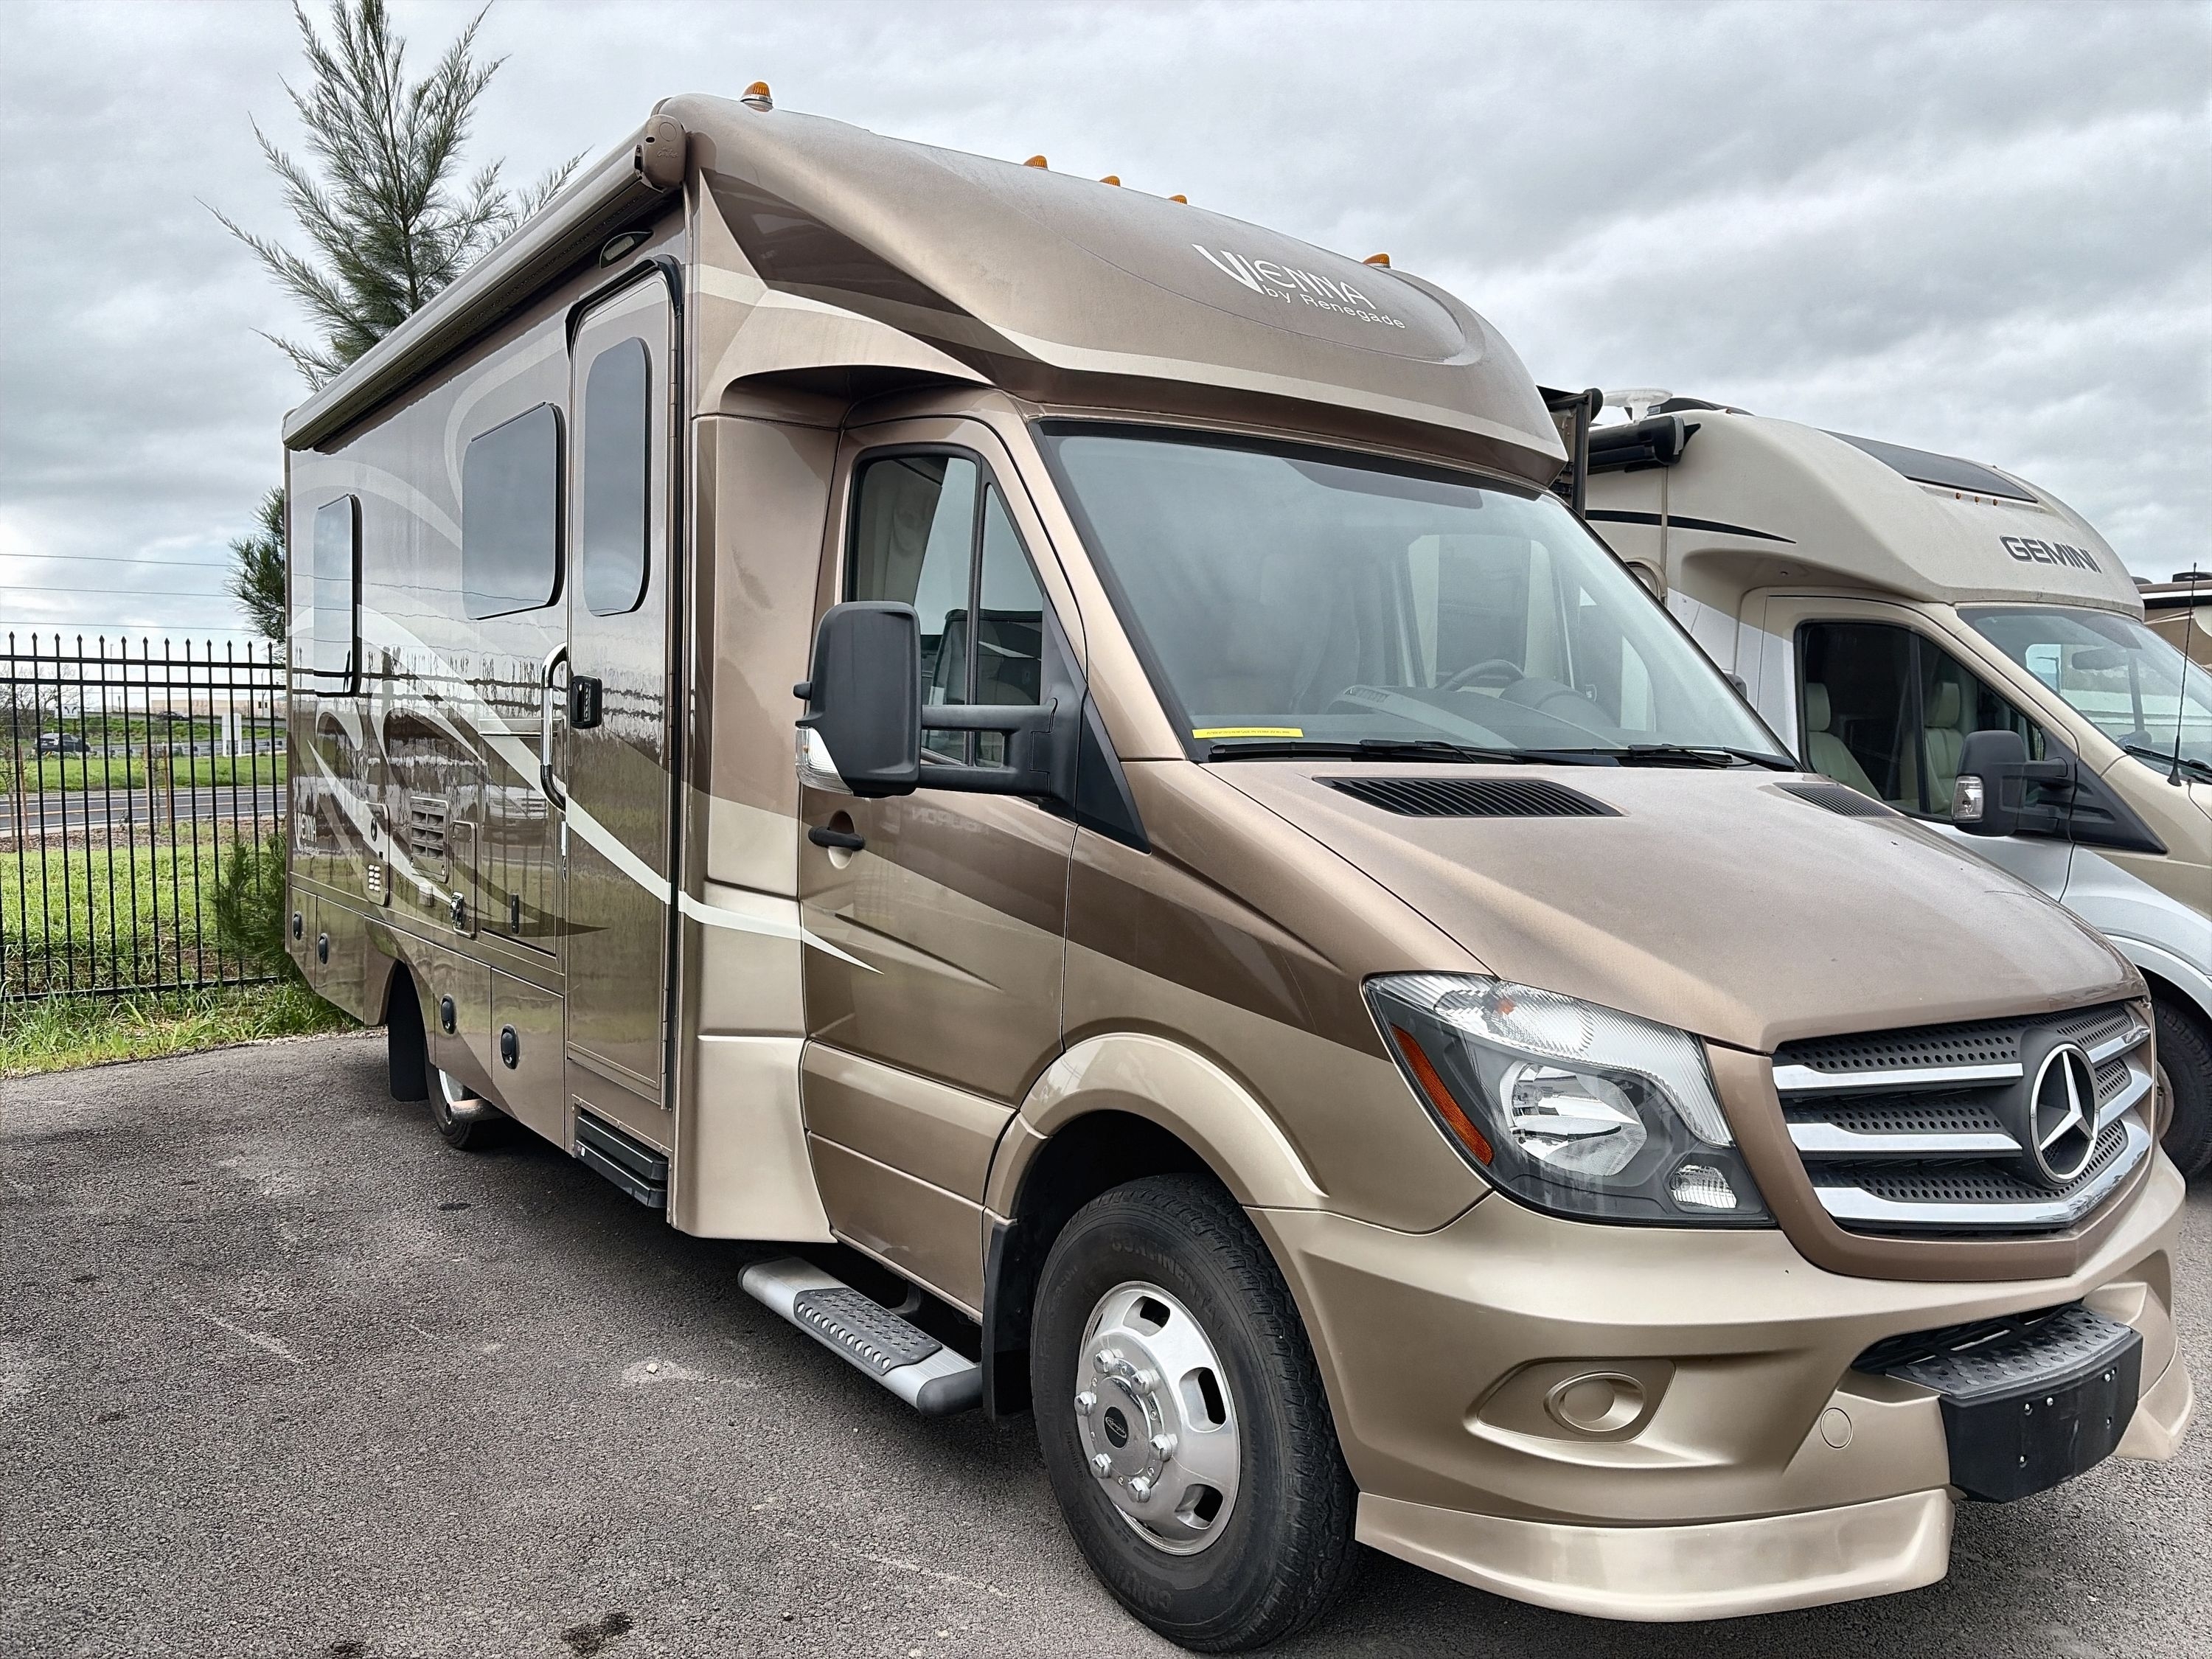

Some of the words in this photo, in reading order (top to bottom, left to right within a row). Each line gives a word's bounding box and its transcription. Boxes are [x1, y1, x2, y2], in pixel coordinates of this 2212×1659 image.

[1191, 243, 1377, 309] VIENNA
[1262, 284, 1291, 303] by
[1299, 293, 1405, 329] Renegade
[2000, 535, 2103, 574] GEMINI
